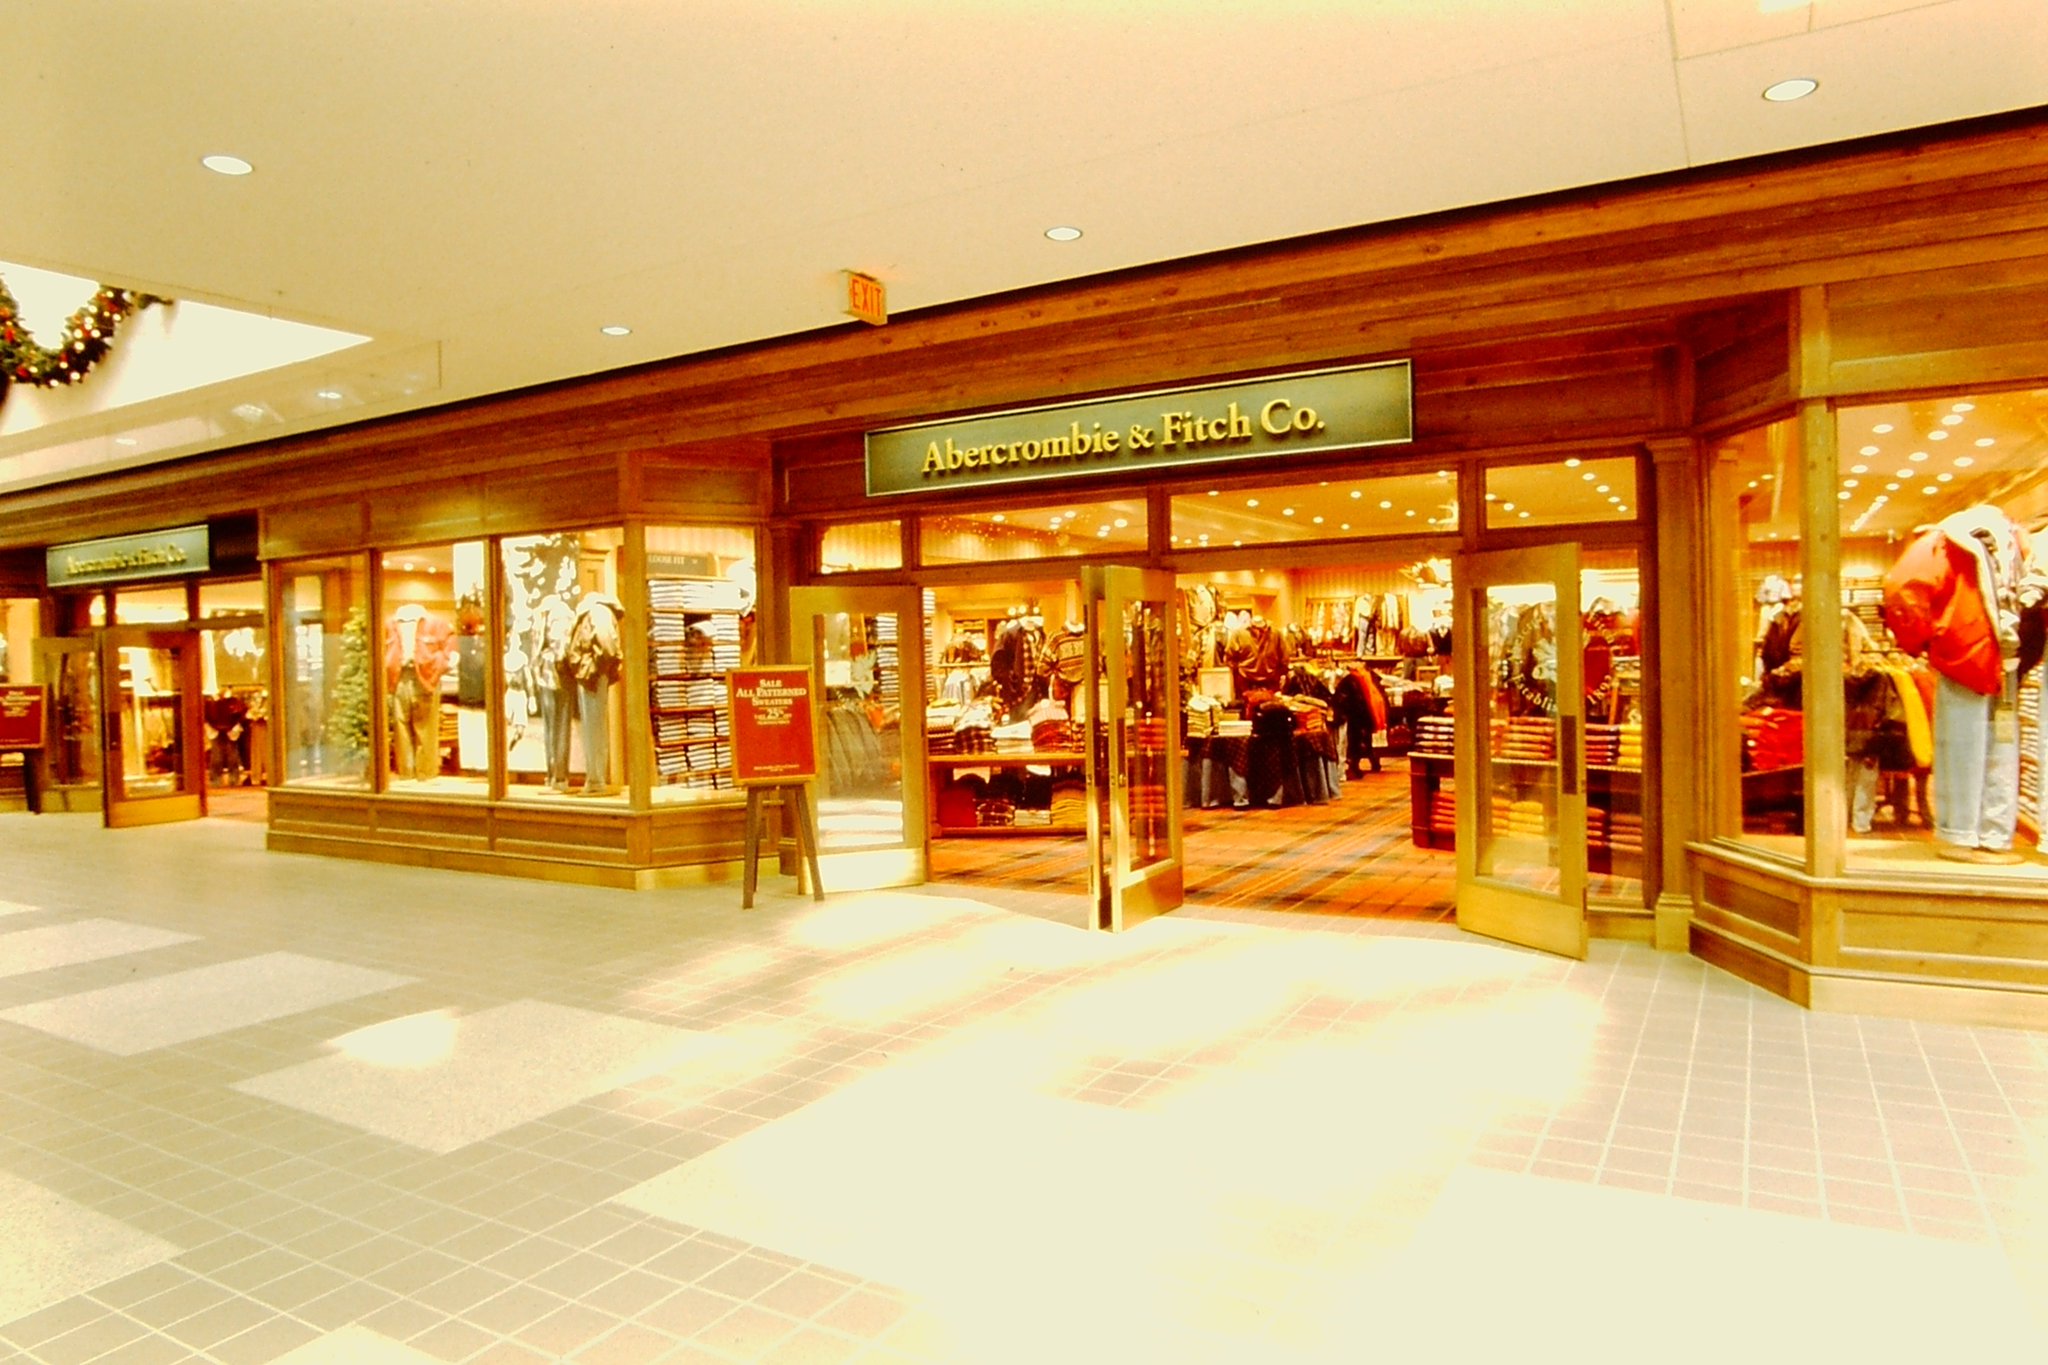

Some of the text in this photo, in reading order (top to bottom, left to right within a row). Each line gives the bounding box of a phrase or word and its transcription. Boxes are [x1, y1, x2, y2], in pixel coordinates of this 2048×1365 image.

[851, 278, 882, 317] EXIT
[922, 398, 1326, 473] Abercrombie & Fitch Co.
[736, 688, 754, 698] ALL
[760, 679, 782, 688] SALE
